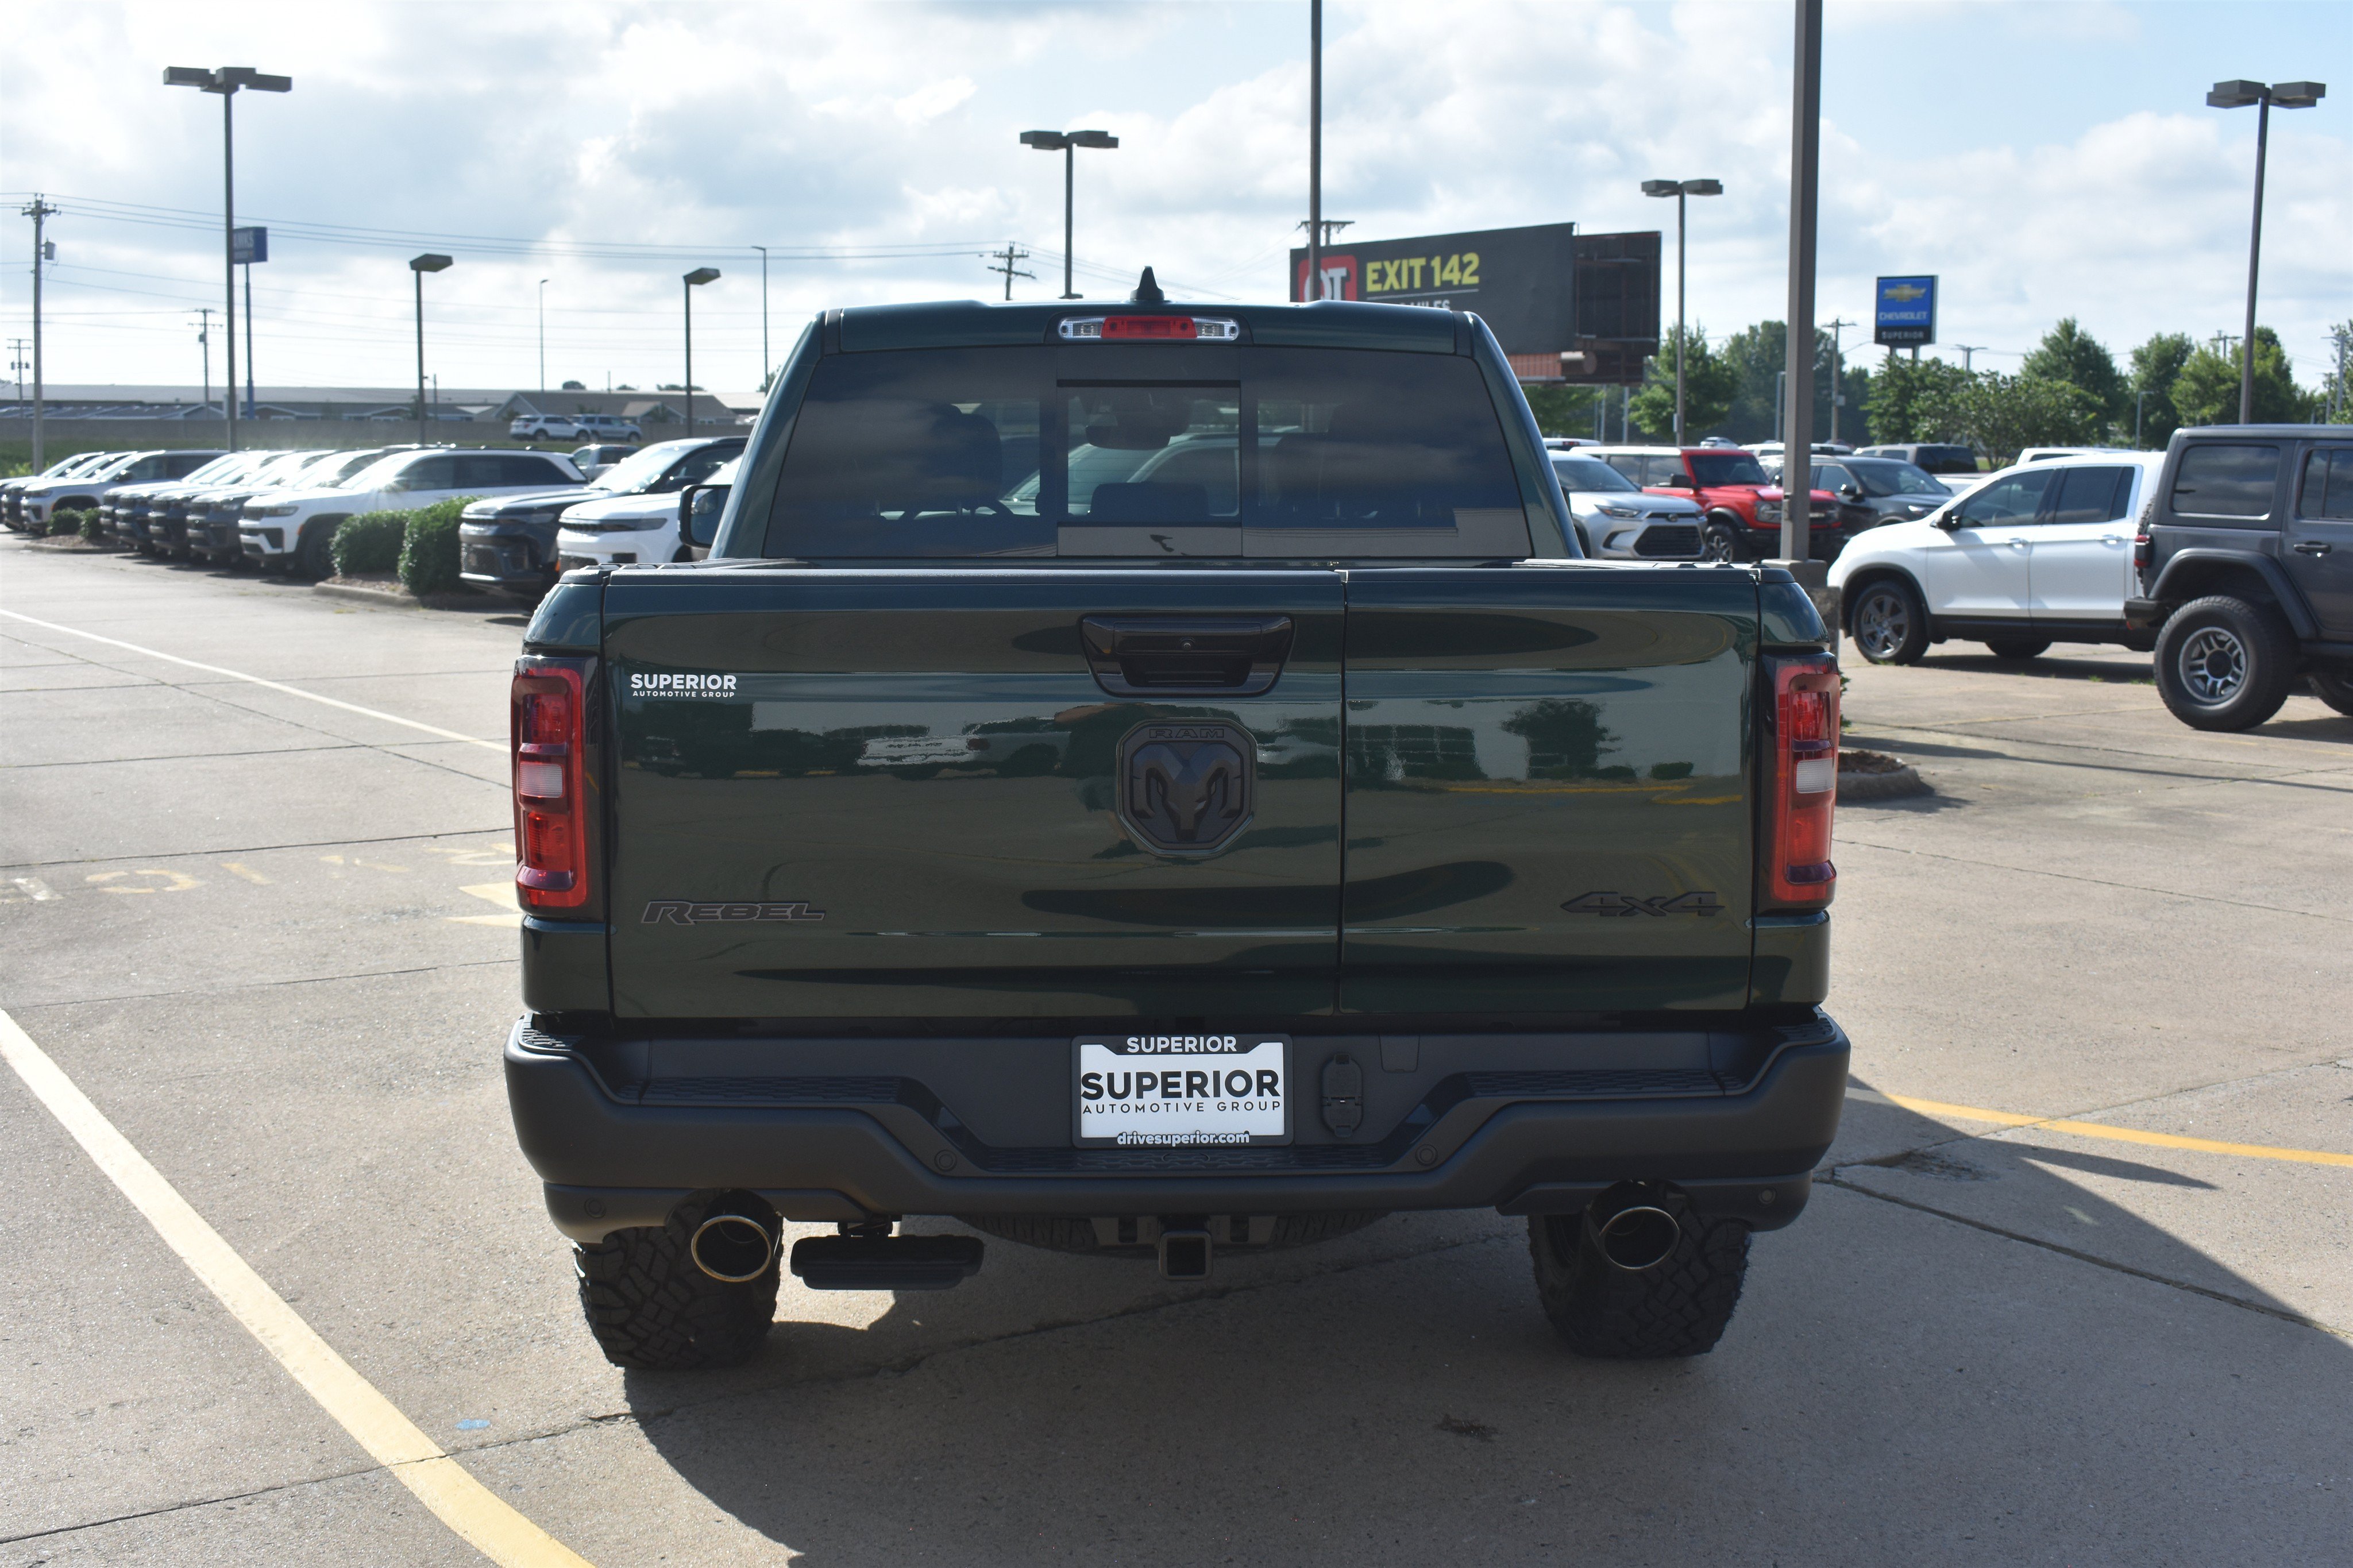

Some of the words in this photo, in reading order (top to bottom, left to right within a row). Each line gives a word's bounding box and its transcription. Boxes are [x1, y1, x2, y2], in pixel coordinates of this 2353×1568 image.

[1366, 257, 1426, 292] EXIT
[1430, 252, 1480, 287] 142
[1878, 311, 1928, 320] CHEVROLET
[631, 674, 737, 690] SUPERIOR
[1149, 728, 1225, 739] RAM
[641, 900, 826, 925] REBEL
[1127, 1036, 1237, 1053] SUPERIOR
[1081, 1069, 1281, 1100] SUPERIOR
[1082, 1102, 1205, 1114] AUTOMOTIVE
[1217, 1101, 1281, 1112] GROUP
[1117, 1130, 1250, 1147] drivesuperior.com
